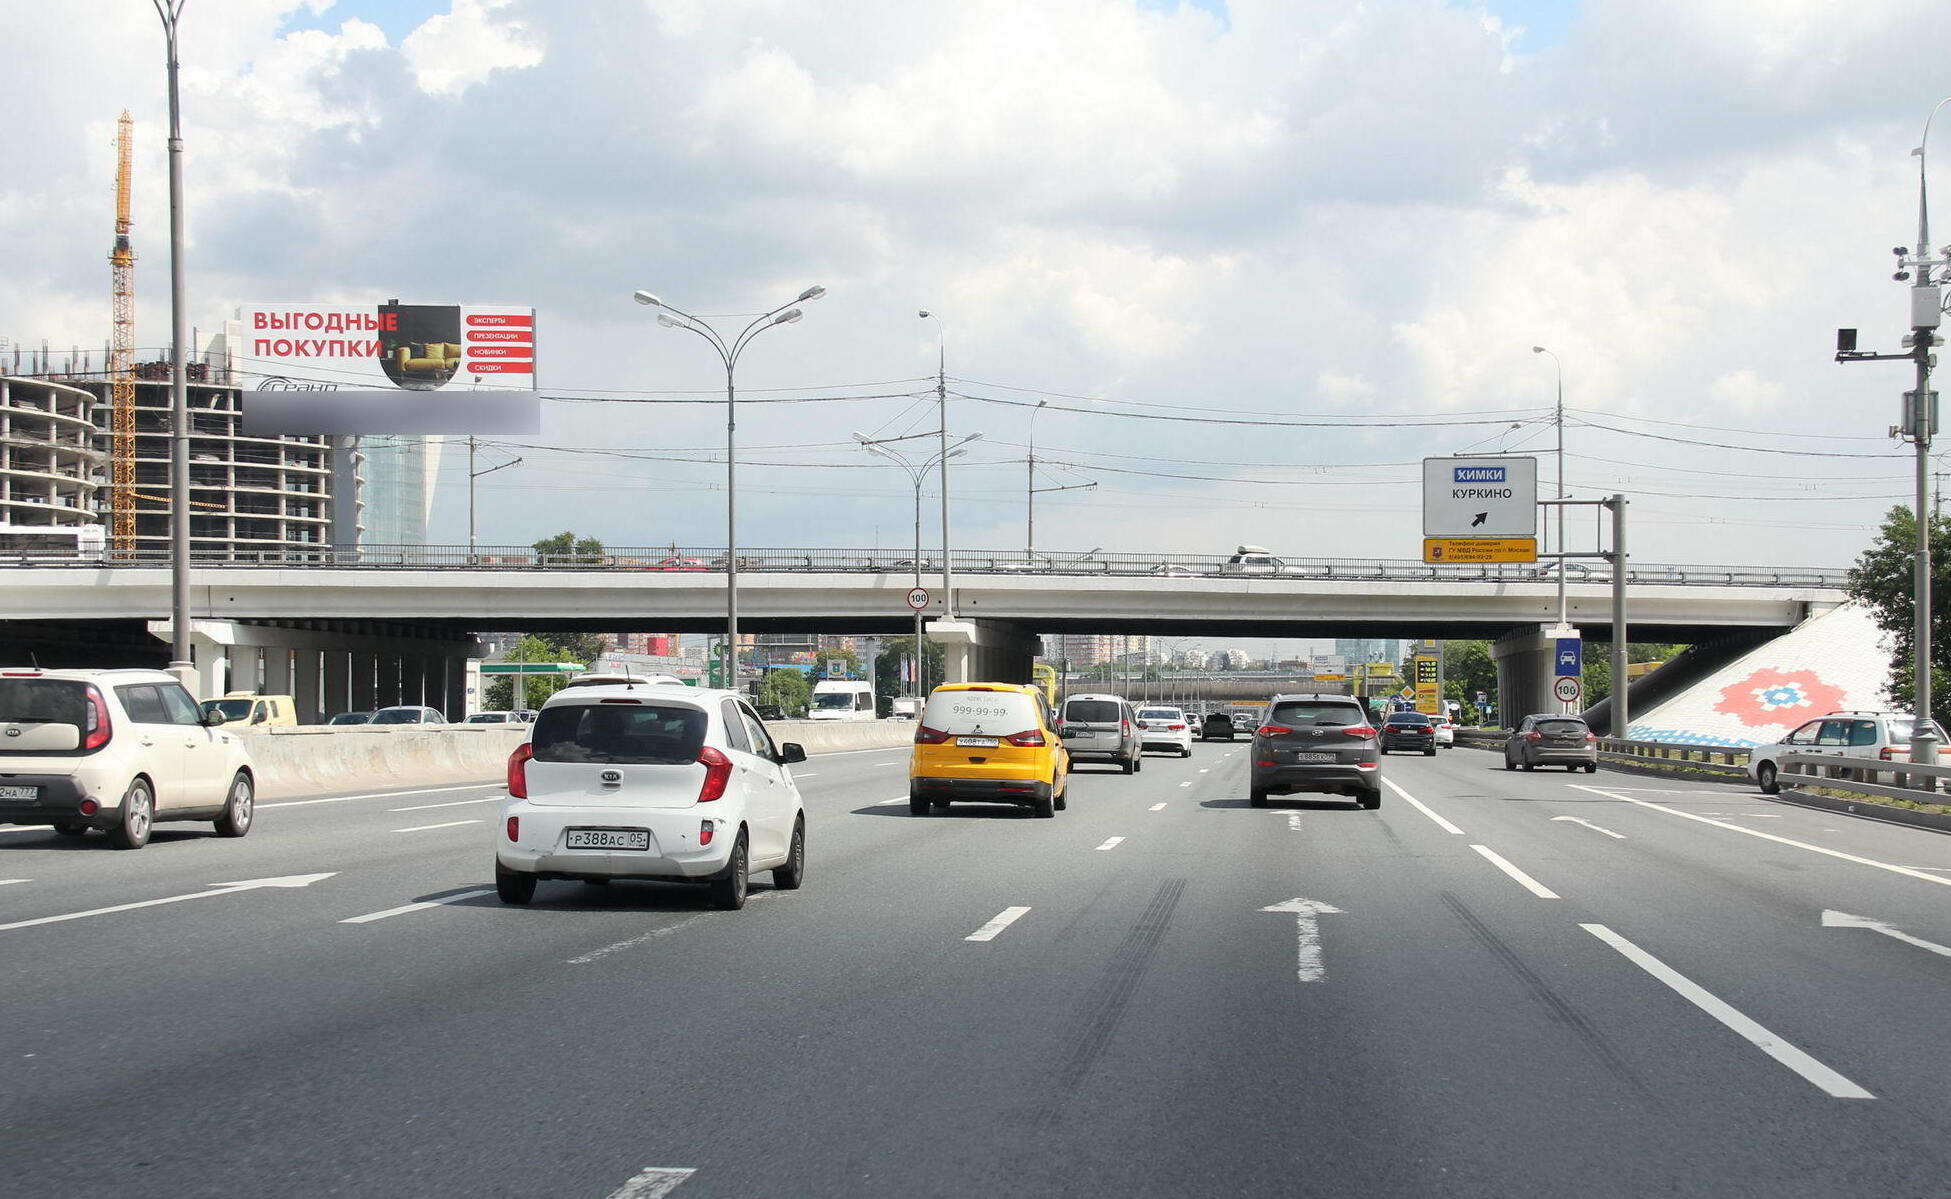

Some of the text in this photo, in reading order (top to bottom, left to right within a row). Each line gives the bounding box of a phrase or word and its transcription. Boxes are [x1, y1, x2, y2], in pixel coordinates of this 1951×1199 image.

[253, 312, 398, 334] ВЫГОДНЫЕ
[254, 339, 384, 358] ПОКУПКИ
[1456, 469, 1504, 481] ХИМКИ
[1452, 488, 1513, 499] КУРКИНО
[911, 594, 927, 602] 100
[1557, 686, 1576, 695] 100
[574, 832, 643, 846] Р388АС 05
